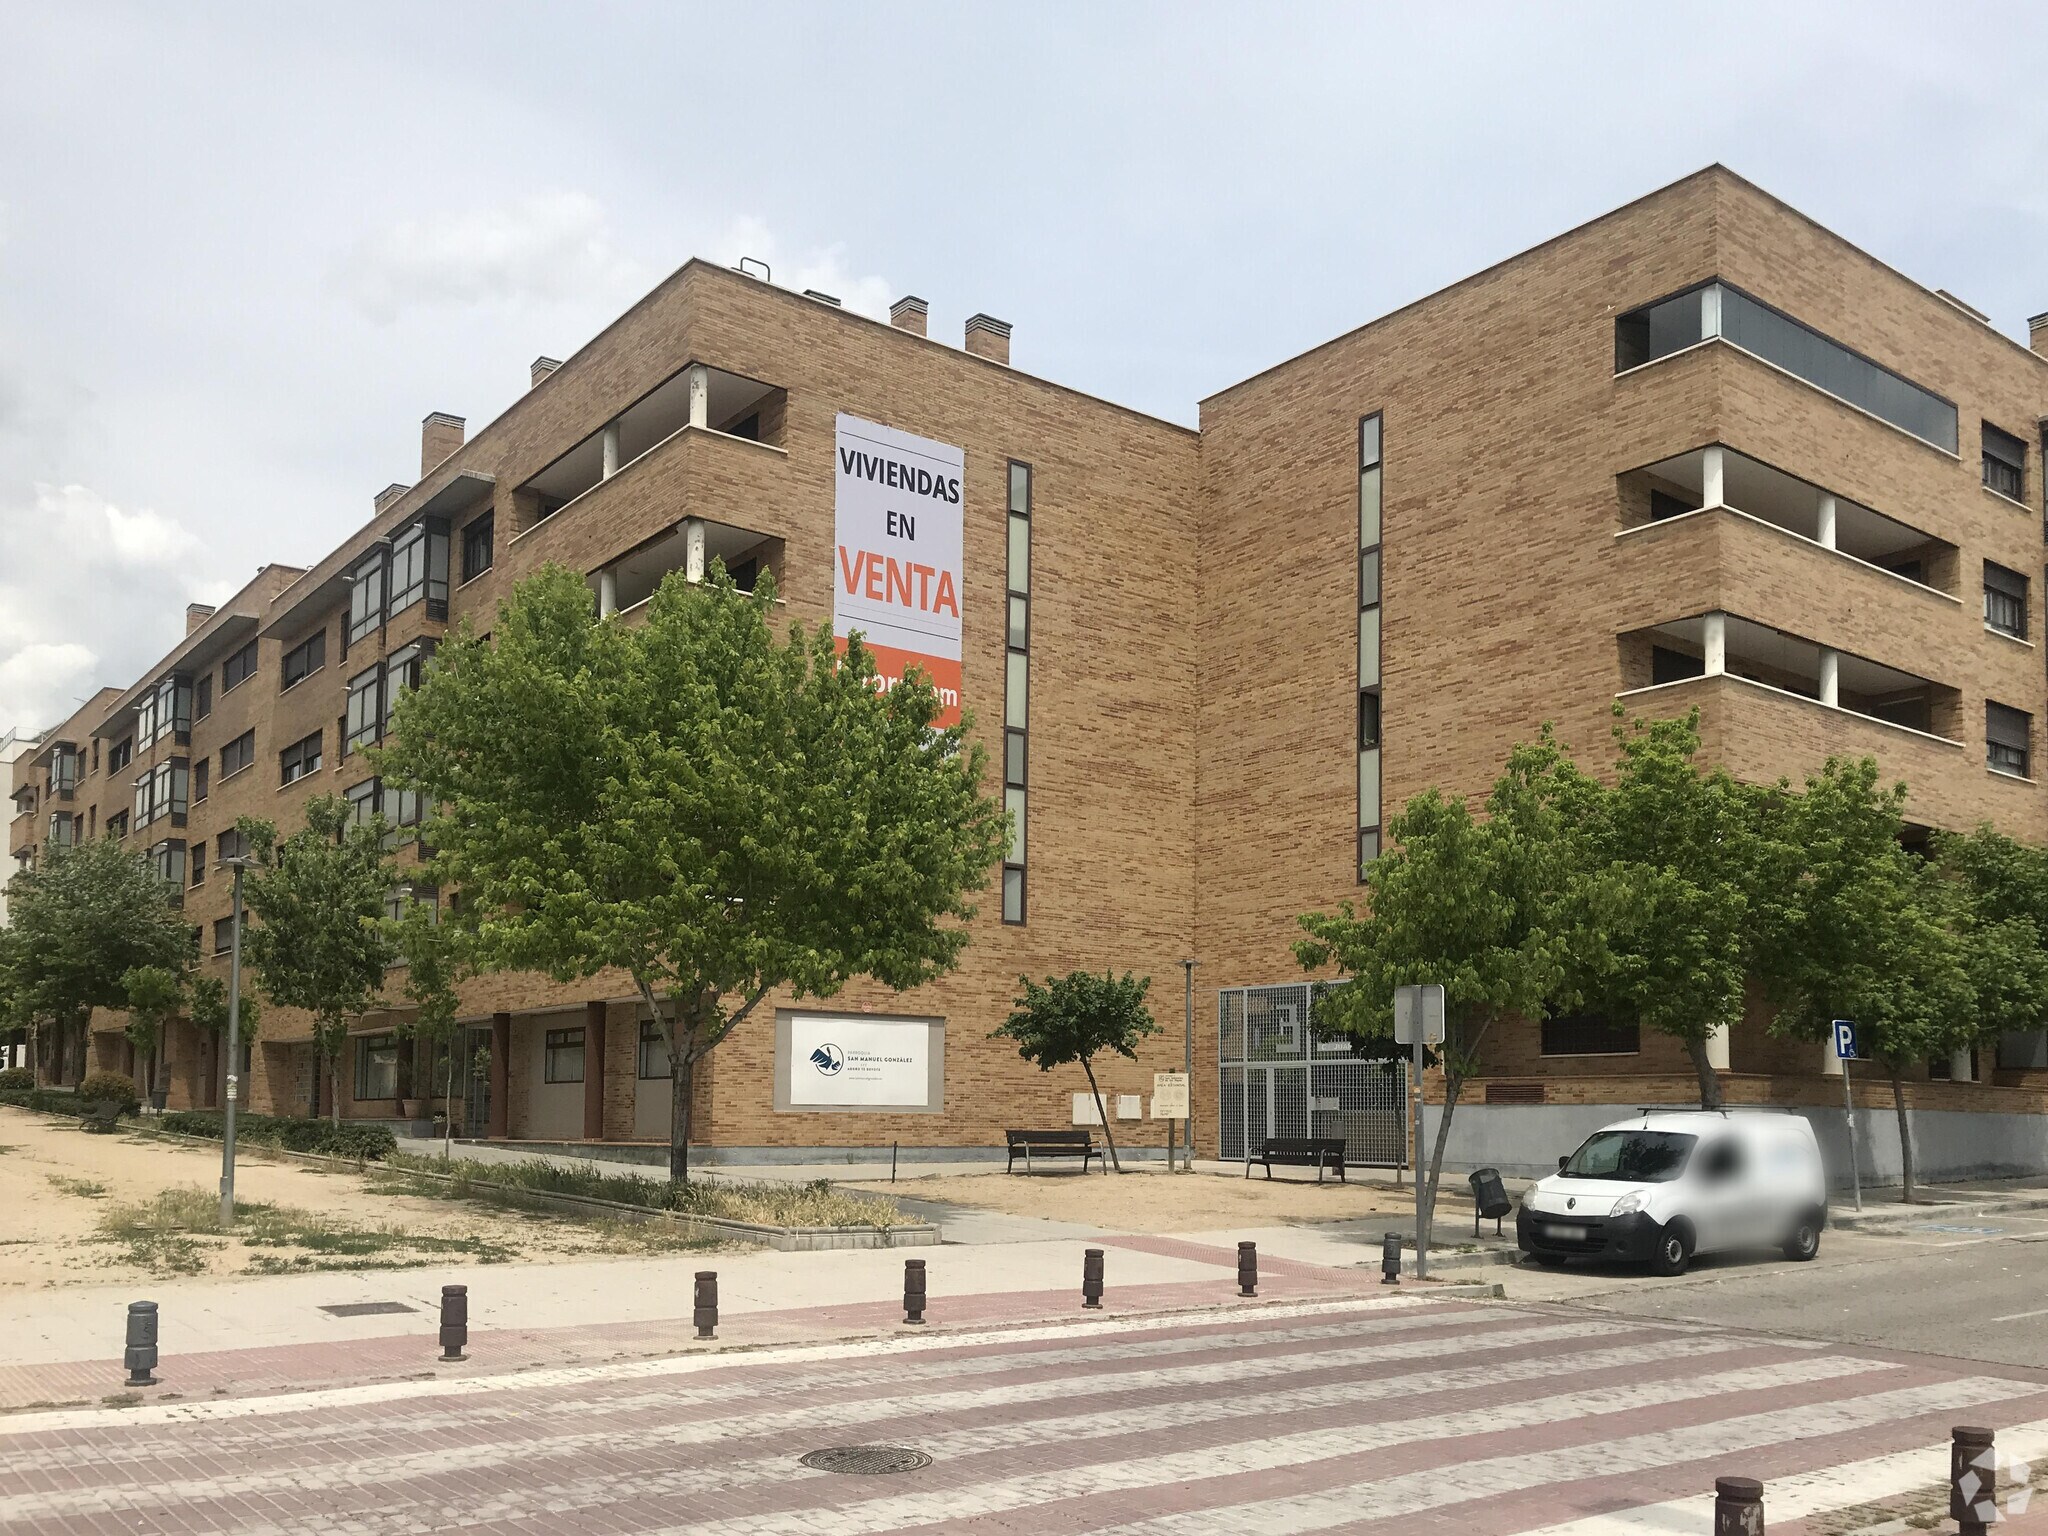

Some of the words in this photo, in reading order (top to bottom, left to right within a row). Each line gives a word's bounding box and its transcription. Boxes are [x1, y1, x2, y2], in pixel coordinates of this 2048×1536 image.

[840, 447, 960, 505] VIVIENDAS
[886, 510, 915, 542] EN
[838, 545, 960, 619] VENTA
[1838, 1025, 1853, 1054] P
